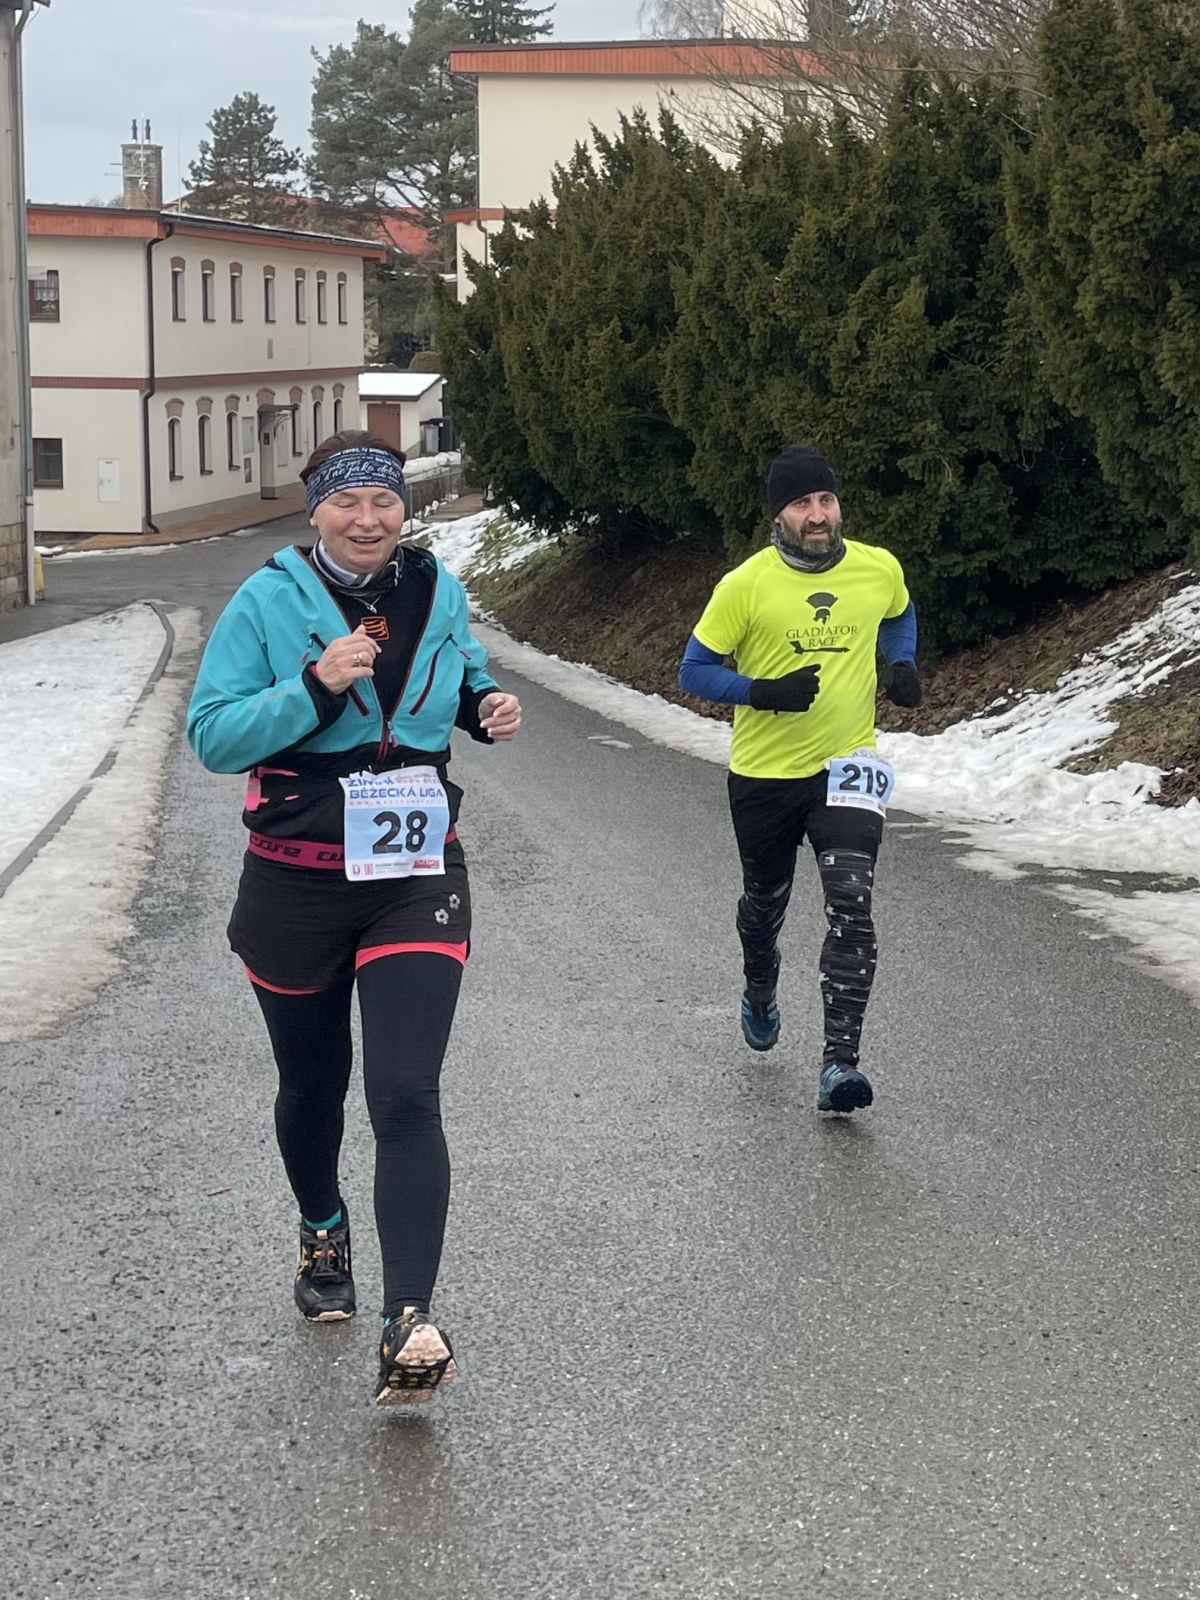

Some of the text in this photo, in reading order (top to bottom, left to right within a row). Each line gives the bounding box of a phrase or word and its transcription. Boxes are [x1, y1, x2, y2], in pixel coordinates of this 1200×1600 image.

[786, 625, 858, 639] GLADIATOR
[808, 637, 839, 648] RACE
[839, 763, 888, 798] 219
[349, 786, 443, 799] BĚŽECKÁ LIGA
[372, 810, 428, 854] 28
